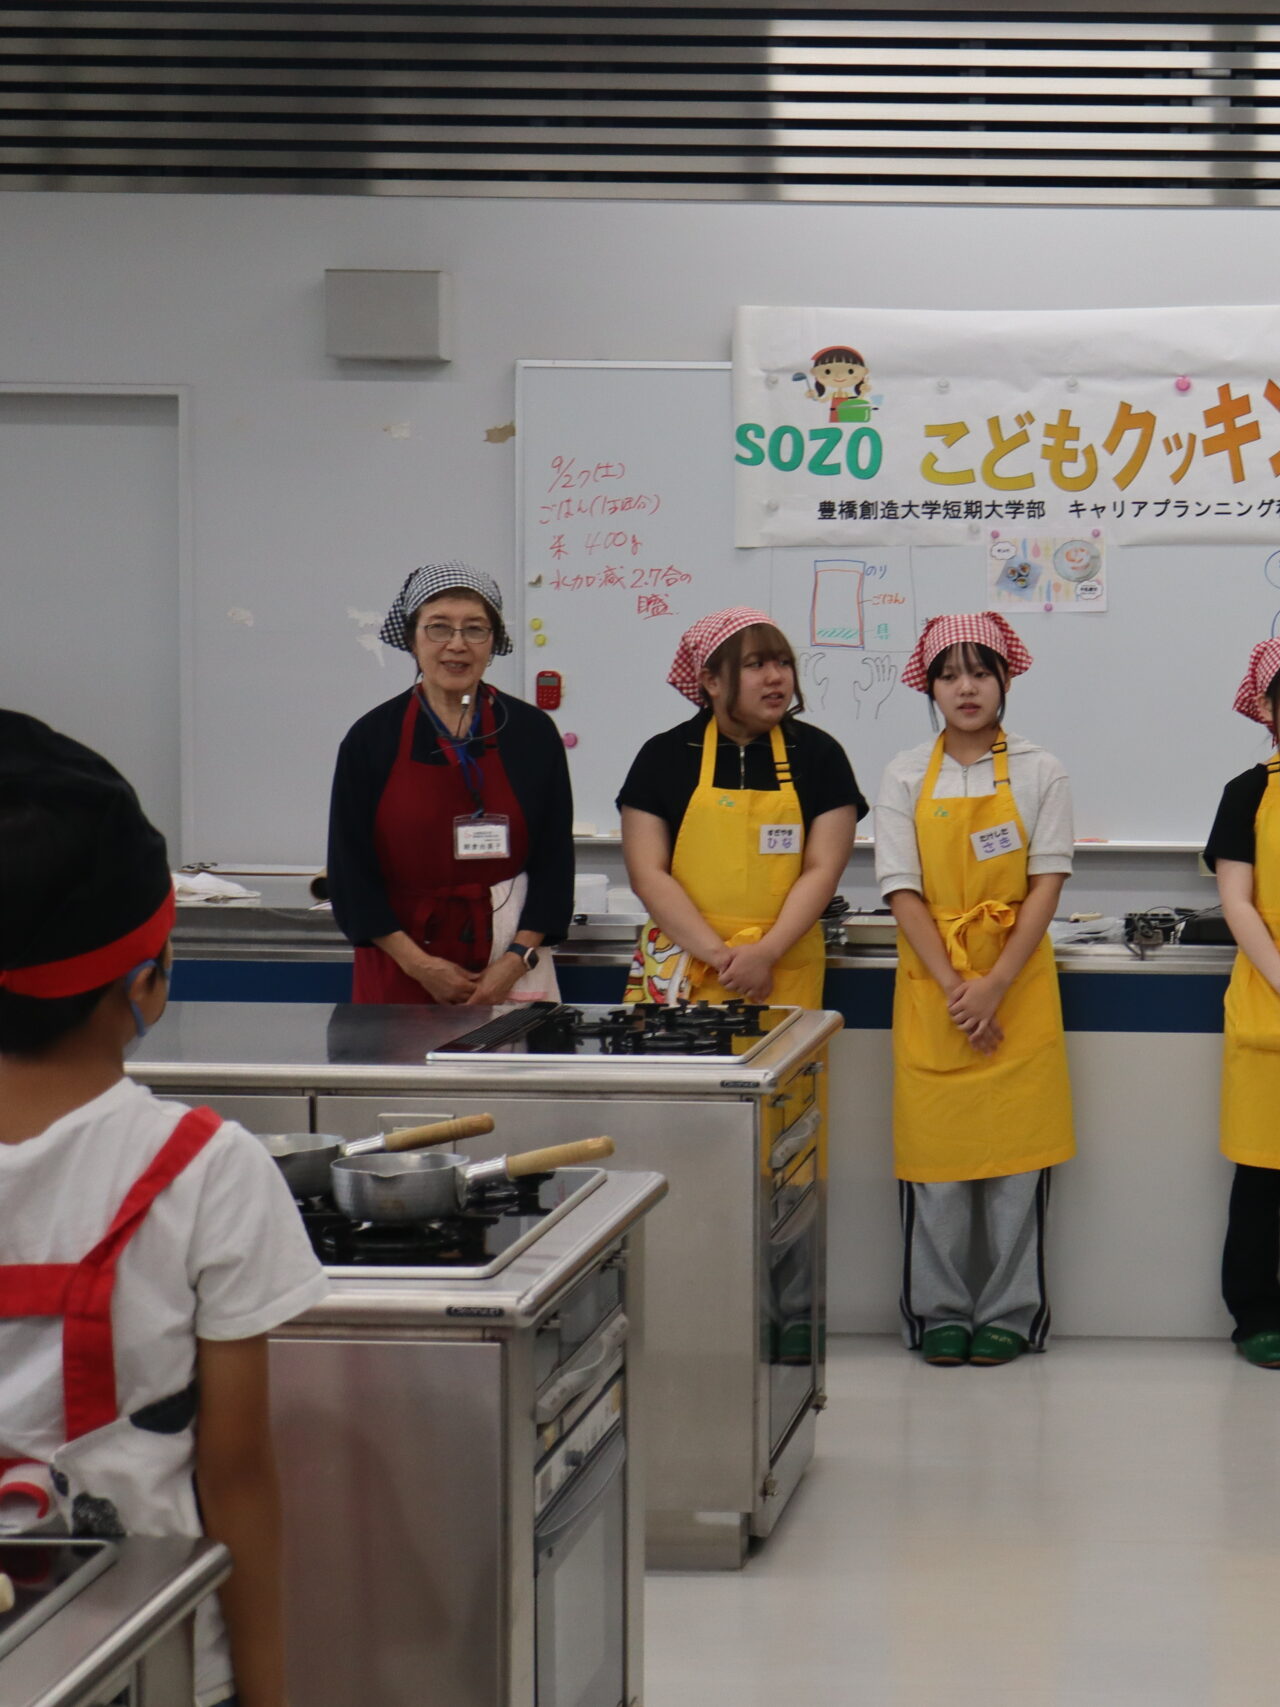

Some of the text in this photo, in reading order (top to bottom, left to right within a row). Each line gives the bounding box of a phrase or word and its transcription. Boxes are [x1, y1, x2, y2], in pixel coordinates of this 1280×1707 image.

[735, 422, 883, 480] SOZO
[818, 499, 1046, 521] 豊橋創造大学短期大学部
